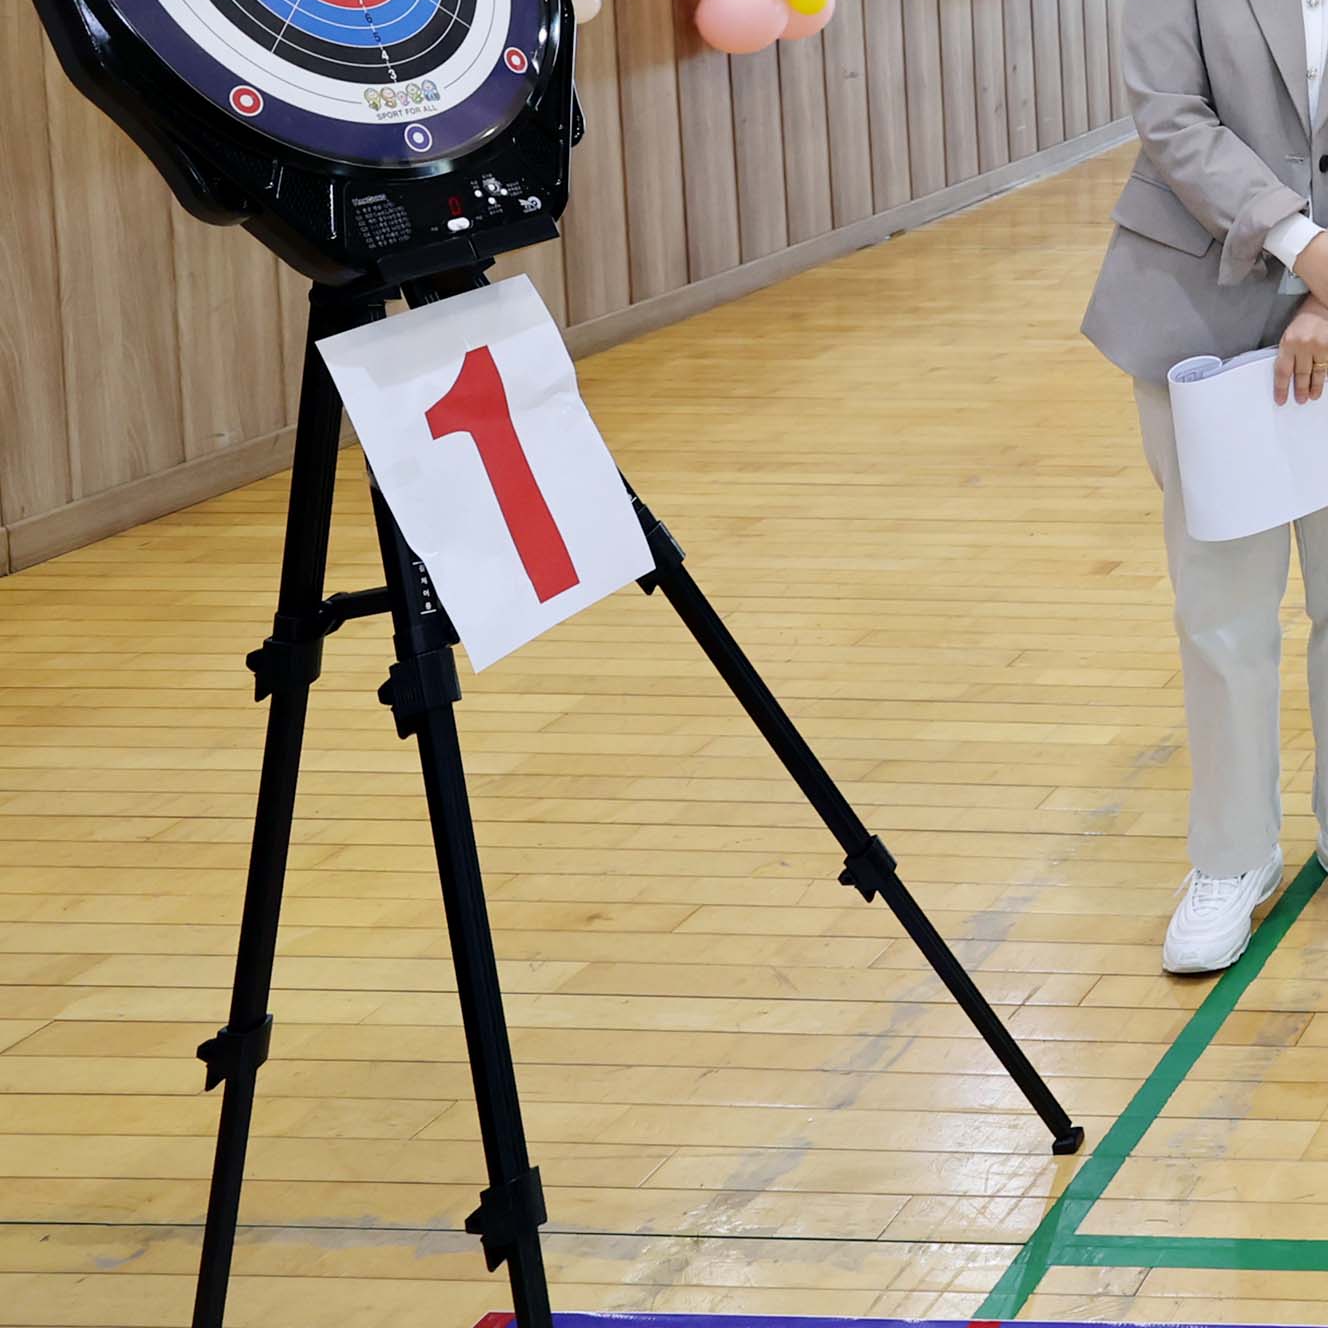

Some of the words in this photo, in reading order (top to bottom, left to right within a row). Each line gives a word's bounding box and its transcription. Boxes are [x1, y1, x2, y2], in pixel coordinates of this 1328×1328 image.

[365, 13, 373, 24] 6
[373, 32, 381, 43] 5
[381, 50, 390, 61] 4
[388, 68, 398, 80] 3
[376, 110, 403, 121] SPORT
[405, 106, 421, 115] FOR
[423, 104, 438, 113] ALL
[425, 345, 580, 604] 1
